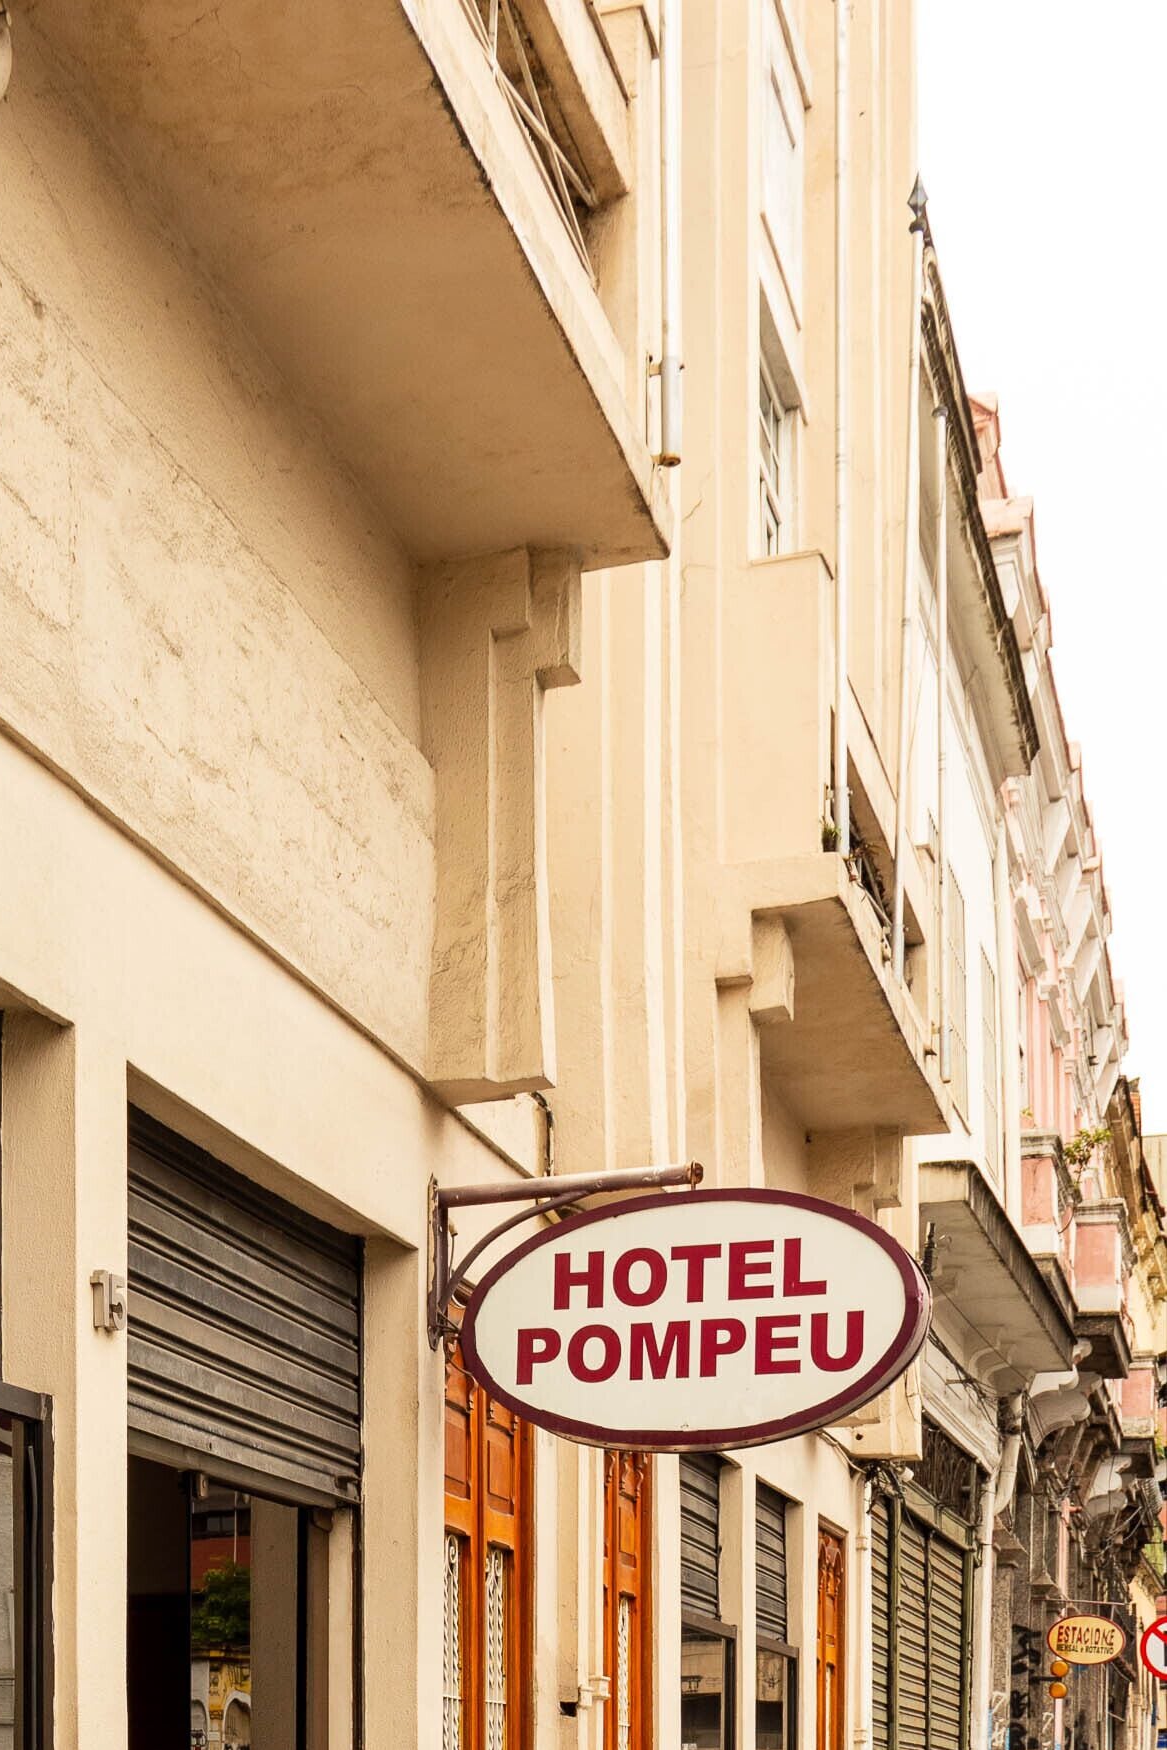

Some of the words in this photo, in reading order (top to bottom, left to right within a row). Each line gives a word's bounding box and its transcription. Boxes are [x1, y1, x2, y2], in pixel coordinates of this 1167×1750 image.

[90, 1270, 127, 1331] 15
[553, 1237, 827, 1311] HOTEL
[516, 1310, 865, 1386] POMPEU
